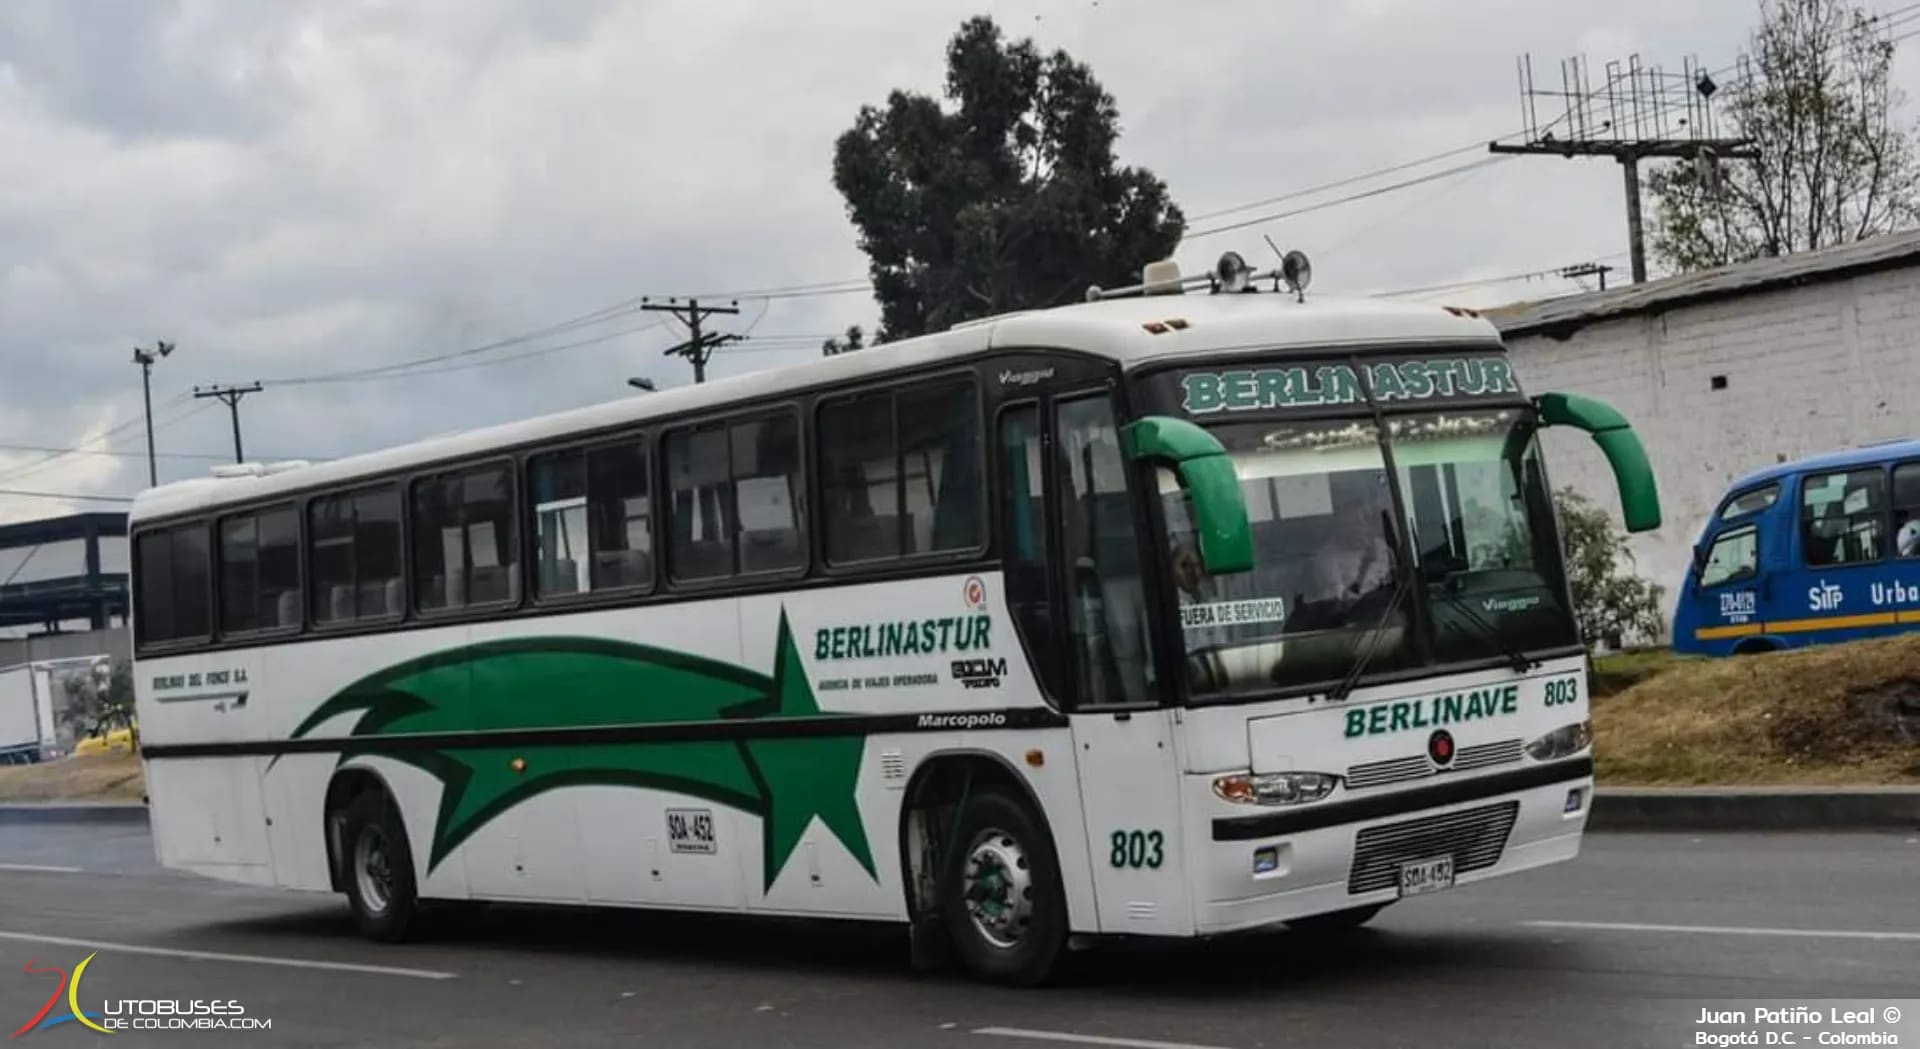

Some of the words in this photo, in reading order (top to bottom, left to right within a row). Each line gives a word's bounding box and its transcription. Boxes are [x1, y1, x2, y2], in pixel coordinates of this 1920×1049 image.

[1182, 358, 1517, 414] BERLINASTUR
[1217, 604, 1232, 623] DE
[1234, 600, 1281, 621] SERVICIO
[815, 614, 991, 661] BERLINASTUR
[852, 678, 862, 690] DE
[865, 676, 889, 688] VIAJES
[893, 673, 938, 687] OPERADORA
[918, 713, 1006, 729] Marcopolo
[1344, 685, 1519, 739] BERLINAVE
[1544, 678, 1578, 707] 803
[1110, 829, 1164, 869] 803
